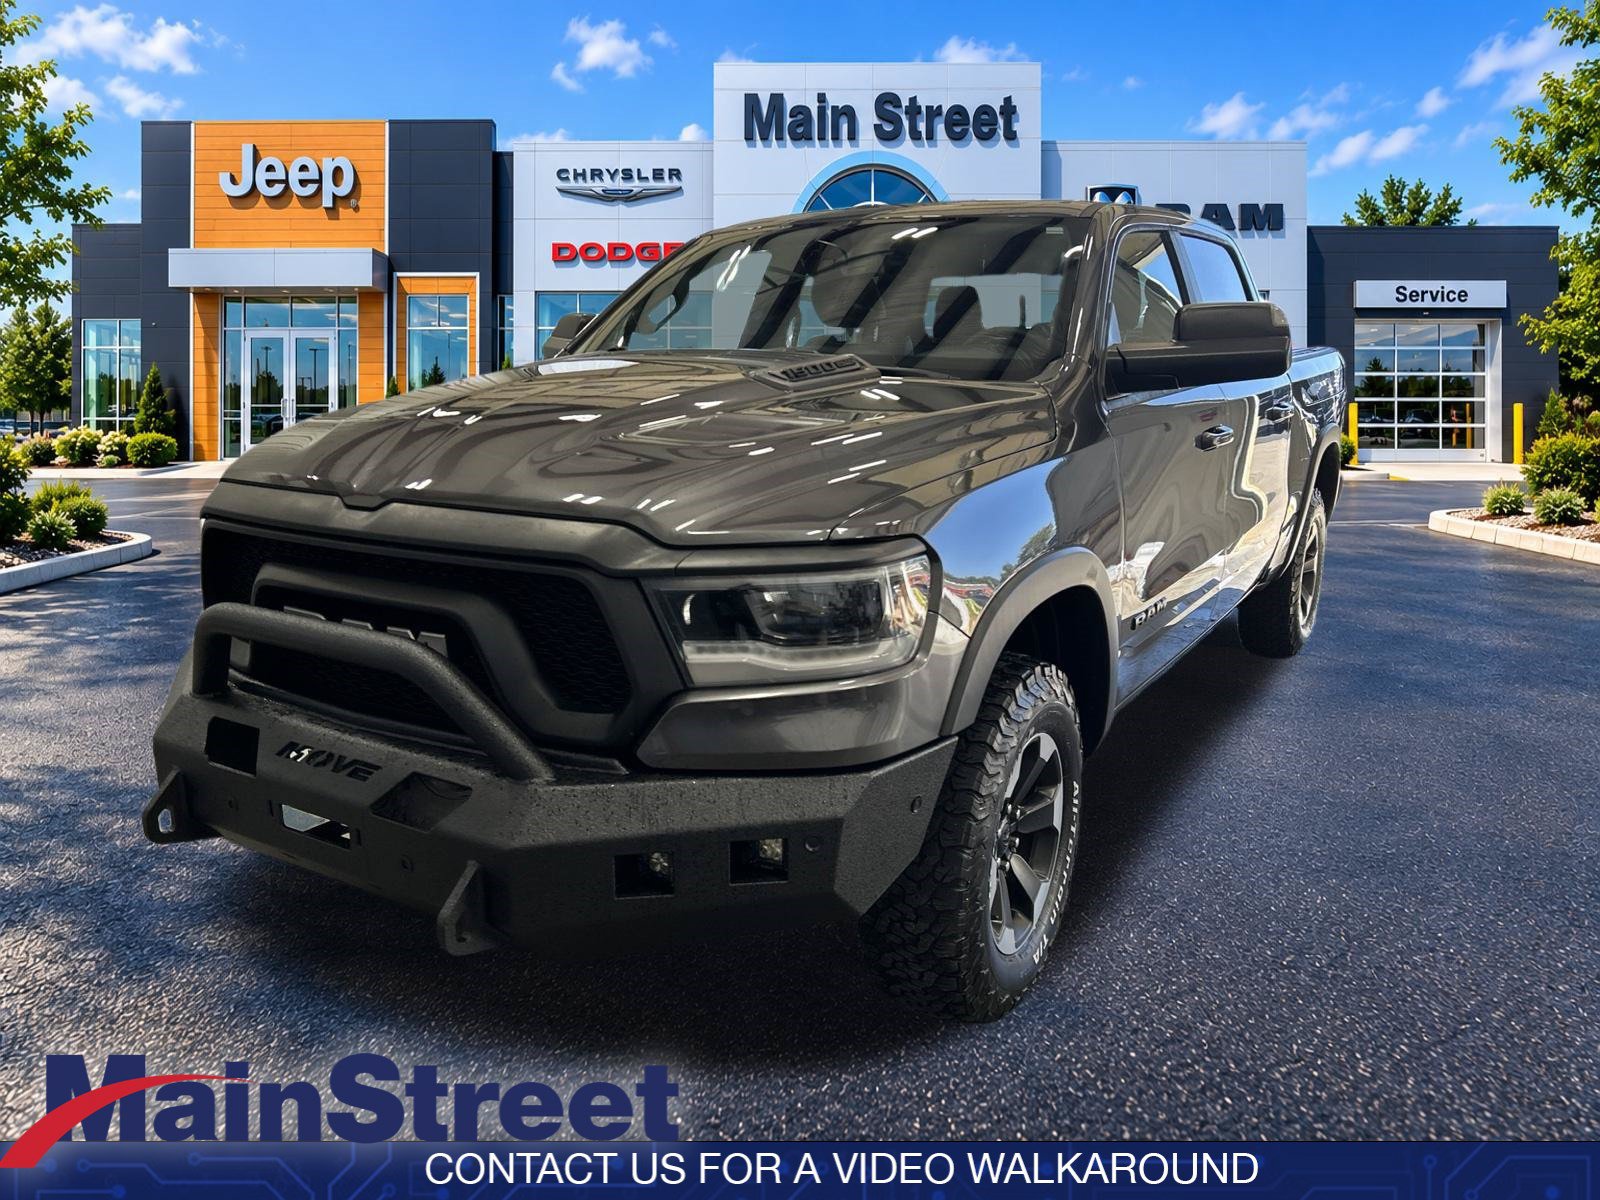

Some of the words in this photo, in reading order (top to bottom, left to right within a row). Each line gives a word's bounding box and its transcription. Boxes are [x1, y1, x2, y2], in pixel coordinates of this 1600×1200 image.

[744, 93, 857, 141] Main
[873, 91, 1018, 142] Street
[218, 143, 355, 208] Jeep
[556, 168, 683, 182] CHRYSLER
[1395, 285, 1469, 303] Service
[1130, 597, 1168, 630] RAM
[275, 741, 382, 782] MOVE
